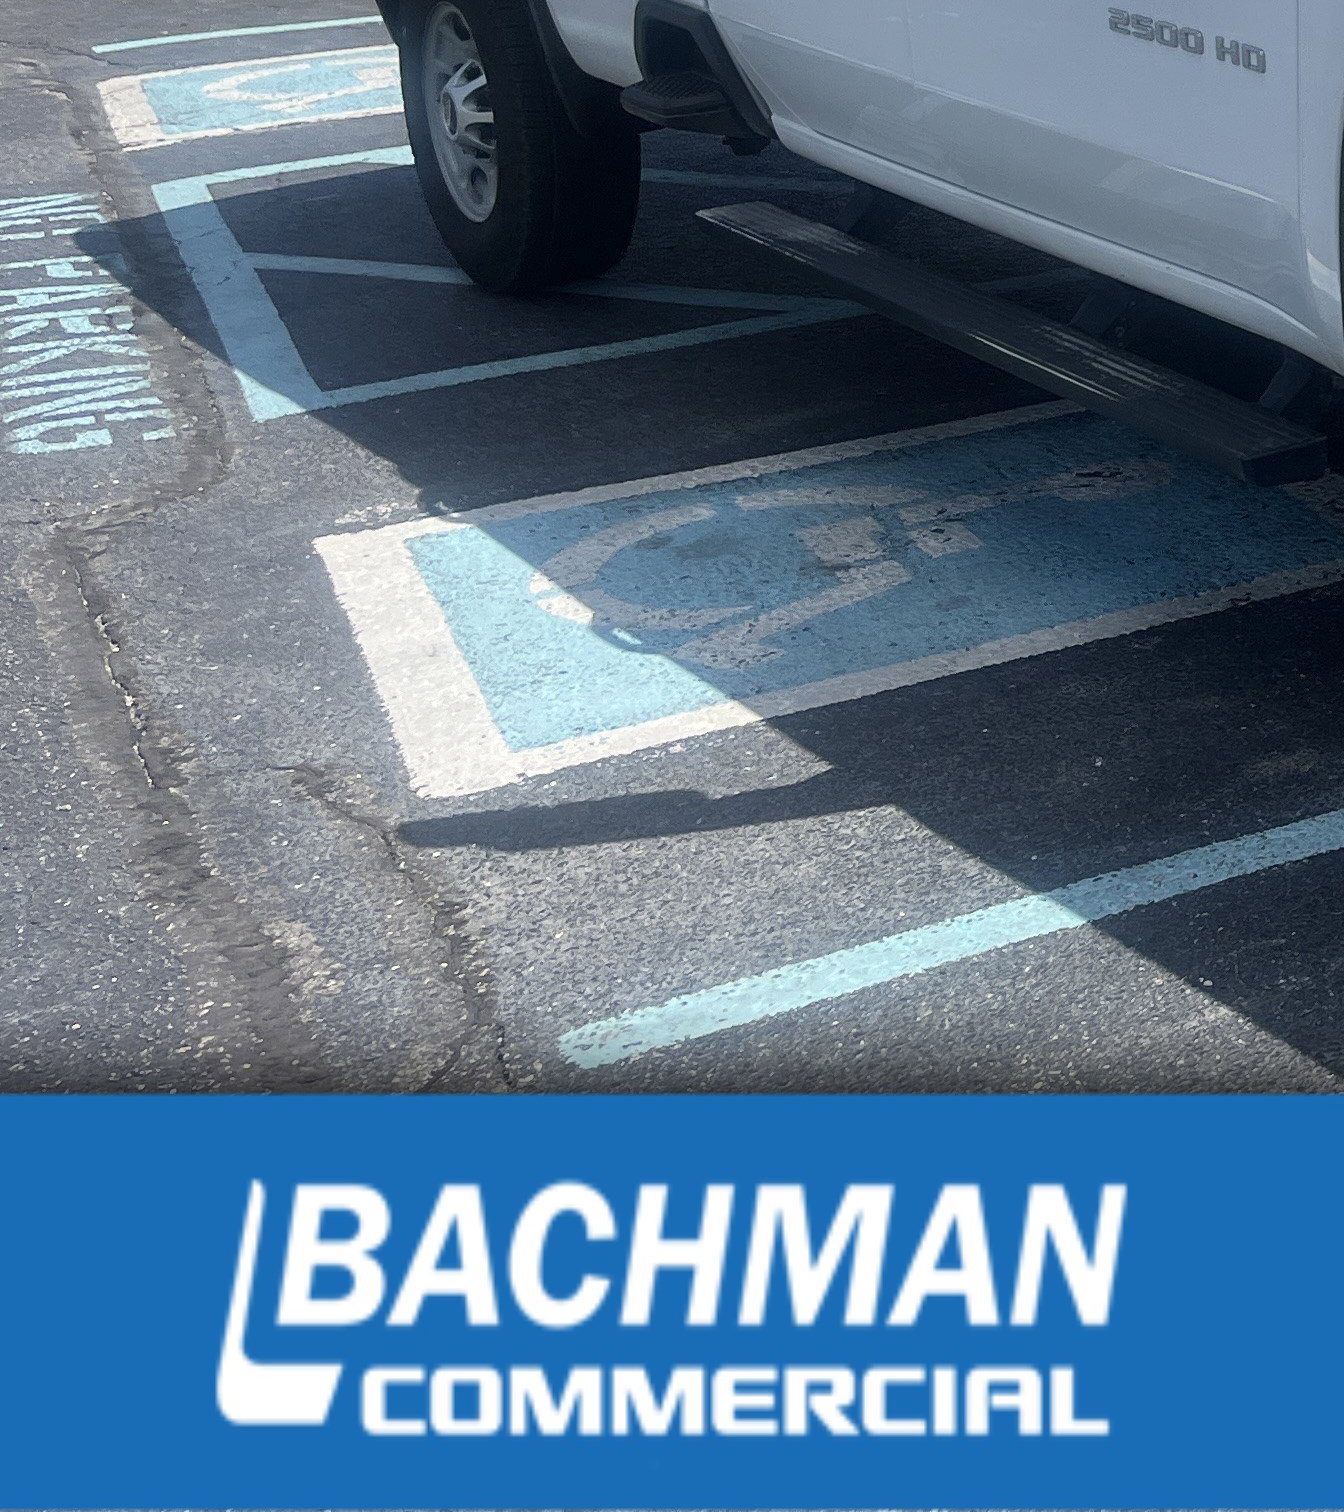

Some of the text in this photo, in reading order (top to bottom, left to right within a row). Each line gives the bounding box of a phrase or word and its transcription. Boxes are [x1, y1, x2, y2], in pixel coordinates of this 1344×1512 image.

[1108, 7, 1267, 74] 2500 HD
[0, 251, 177, 455] PARKING
